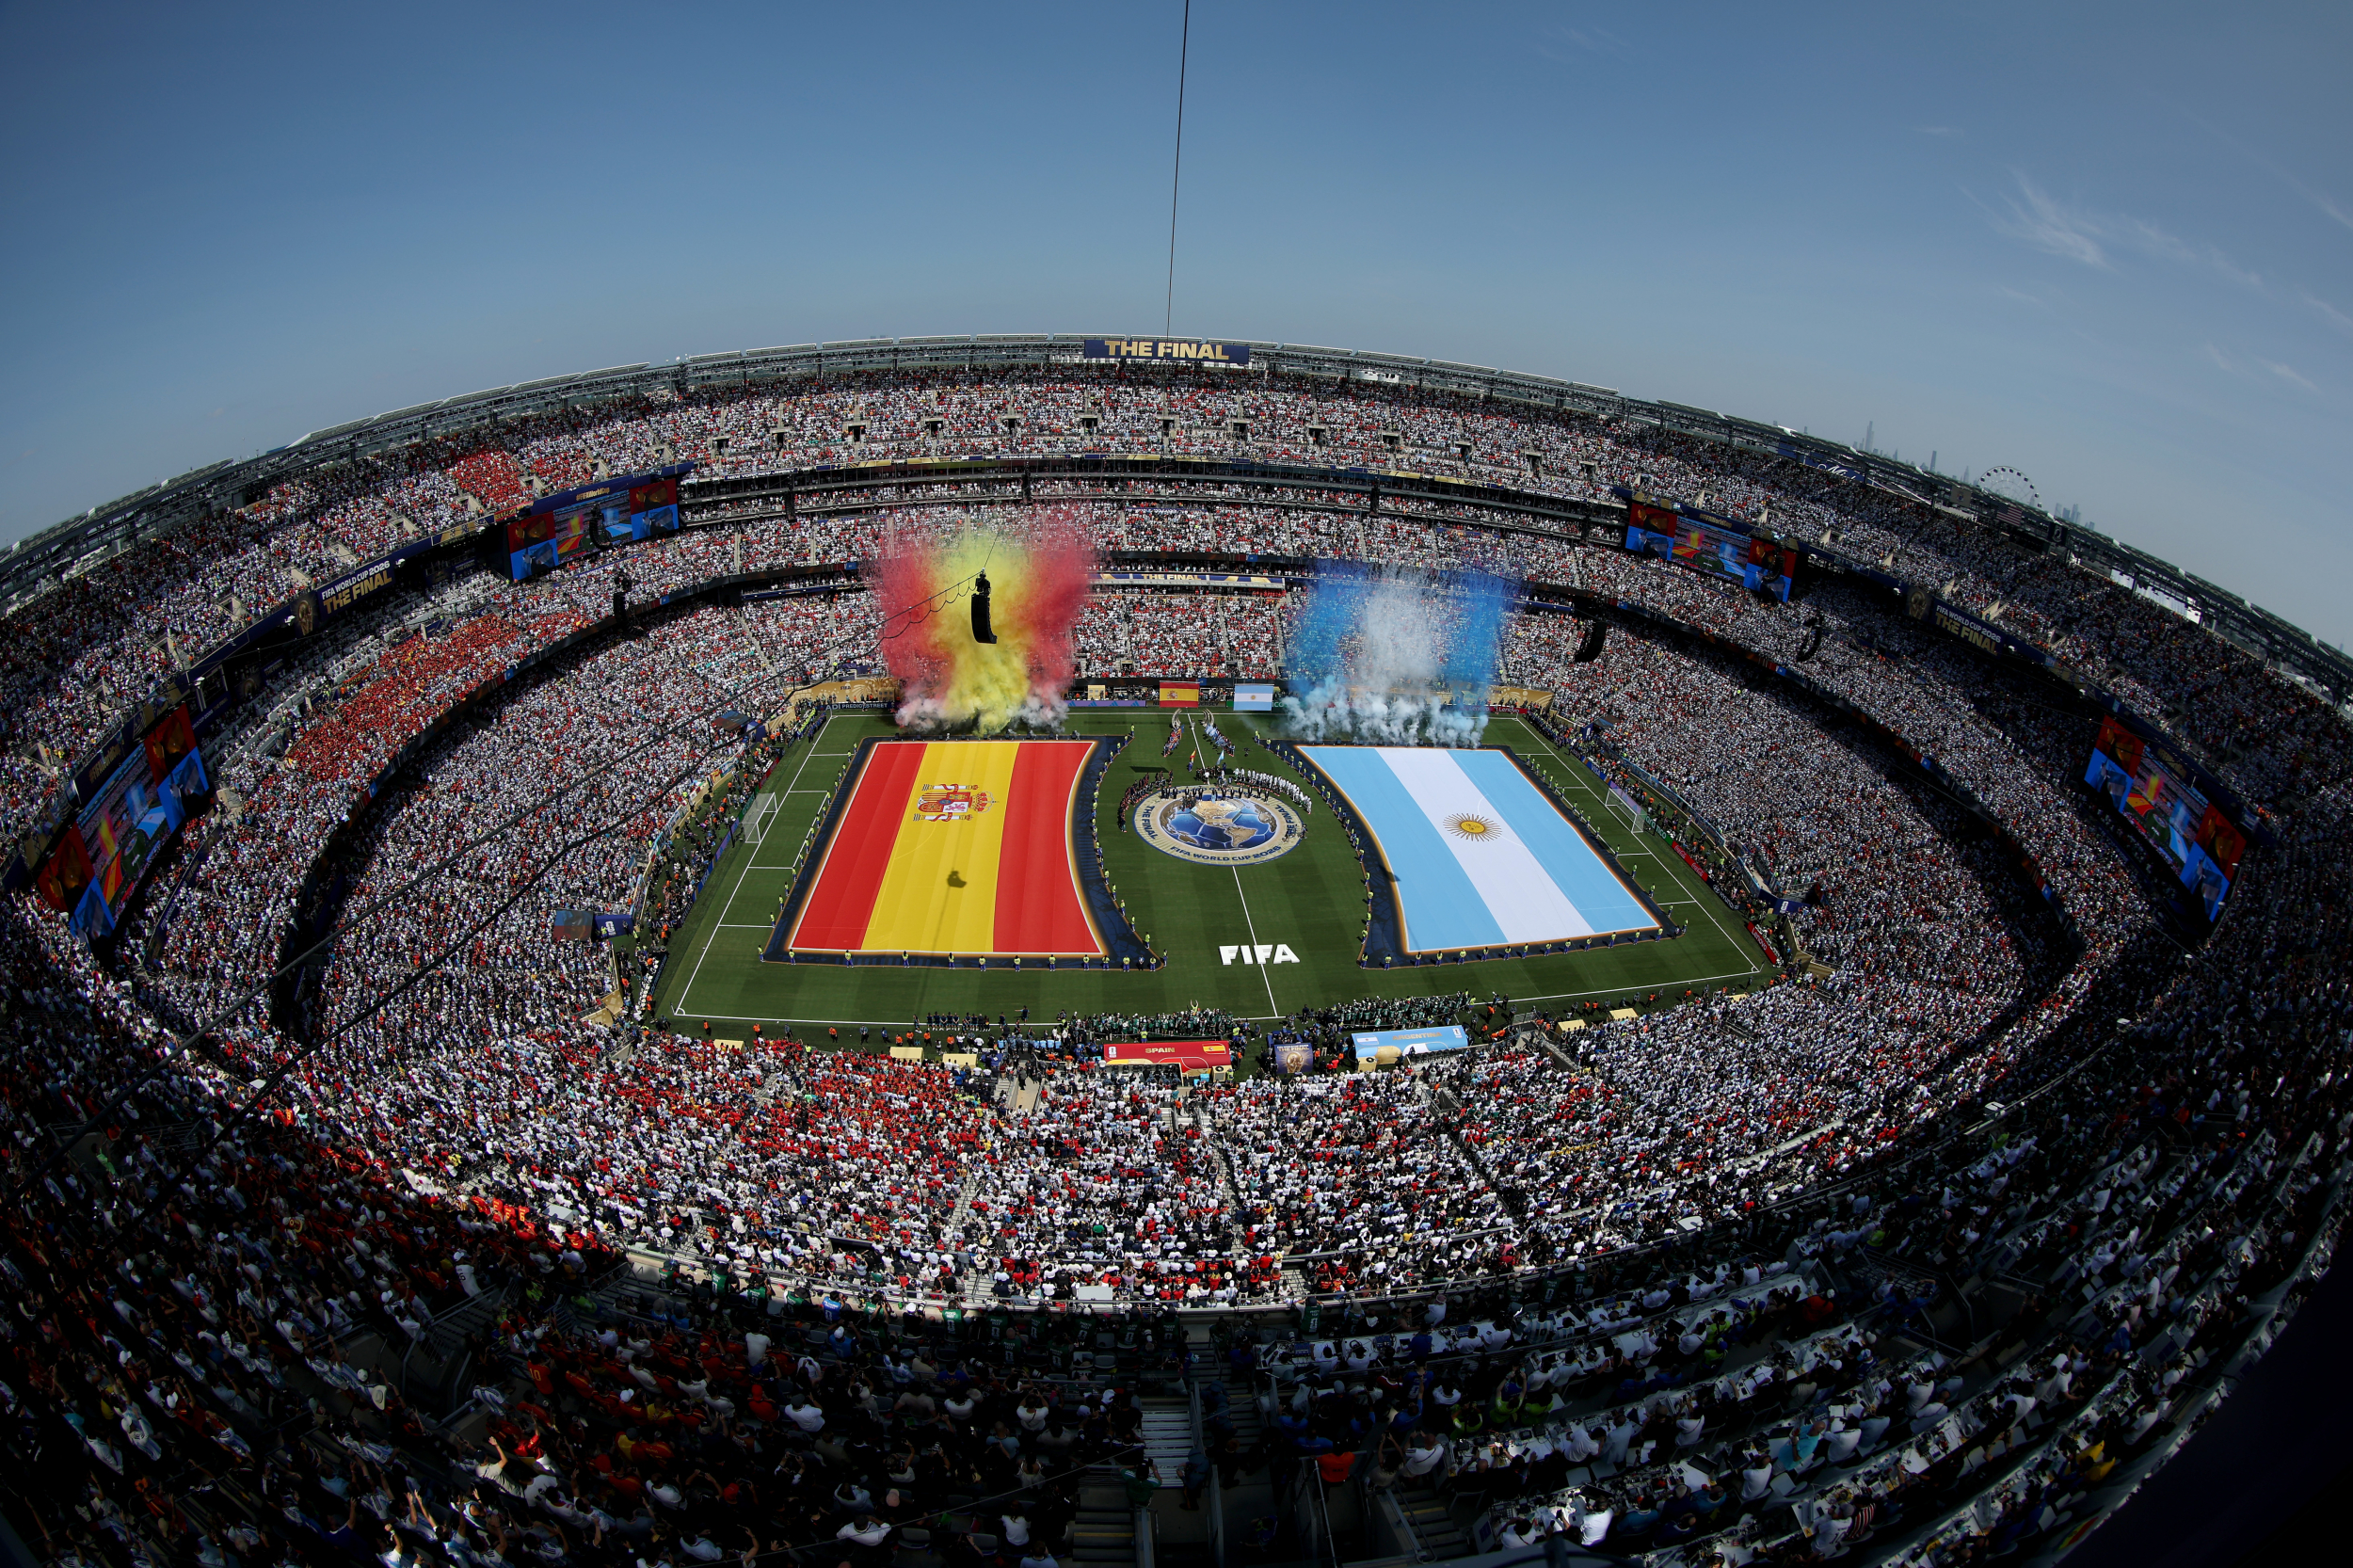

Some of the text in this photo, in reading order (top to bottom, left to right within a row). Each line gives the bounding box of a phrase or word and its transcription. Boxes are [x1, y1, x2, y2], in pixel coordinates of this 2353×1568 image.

[1105, 341, 1229, 360] THE FINAL
[321, 560, 391, 600] FIFA WORLD CUP 2026
[323, 570, 392, 614] THE FINAL
[1935, 612, 1997, 656] THE FINAL
[1936, 605, 2001, 643] FIFA WORLD CUP 2026
[1142, 805, 1158, 840] THE FINAL
[1275, 805, 1295, 824] FINAL
[1170, 845, 1191, 856] FIFA
[1193, 853, 1230, 861] WORLD
[1252, 845, 1282, 858] 2026
[1751, 927, 1768, 951] Lenovo
[1219, 944, 1300, 966] FIFA
[1393, 1032, 1443, 1041] ARGENTINA
[1535, 1328, 1547, 1337] 10
[529, 1368, 541, 1382] 10
